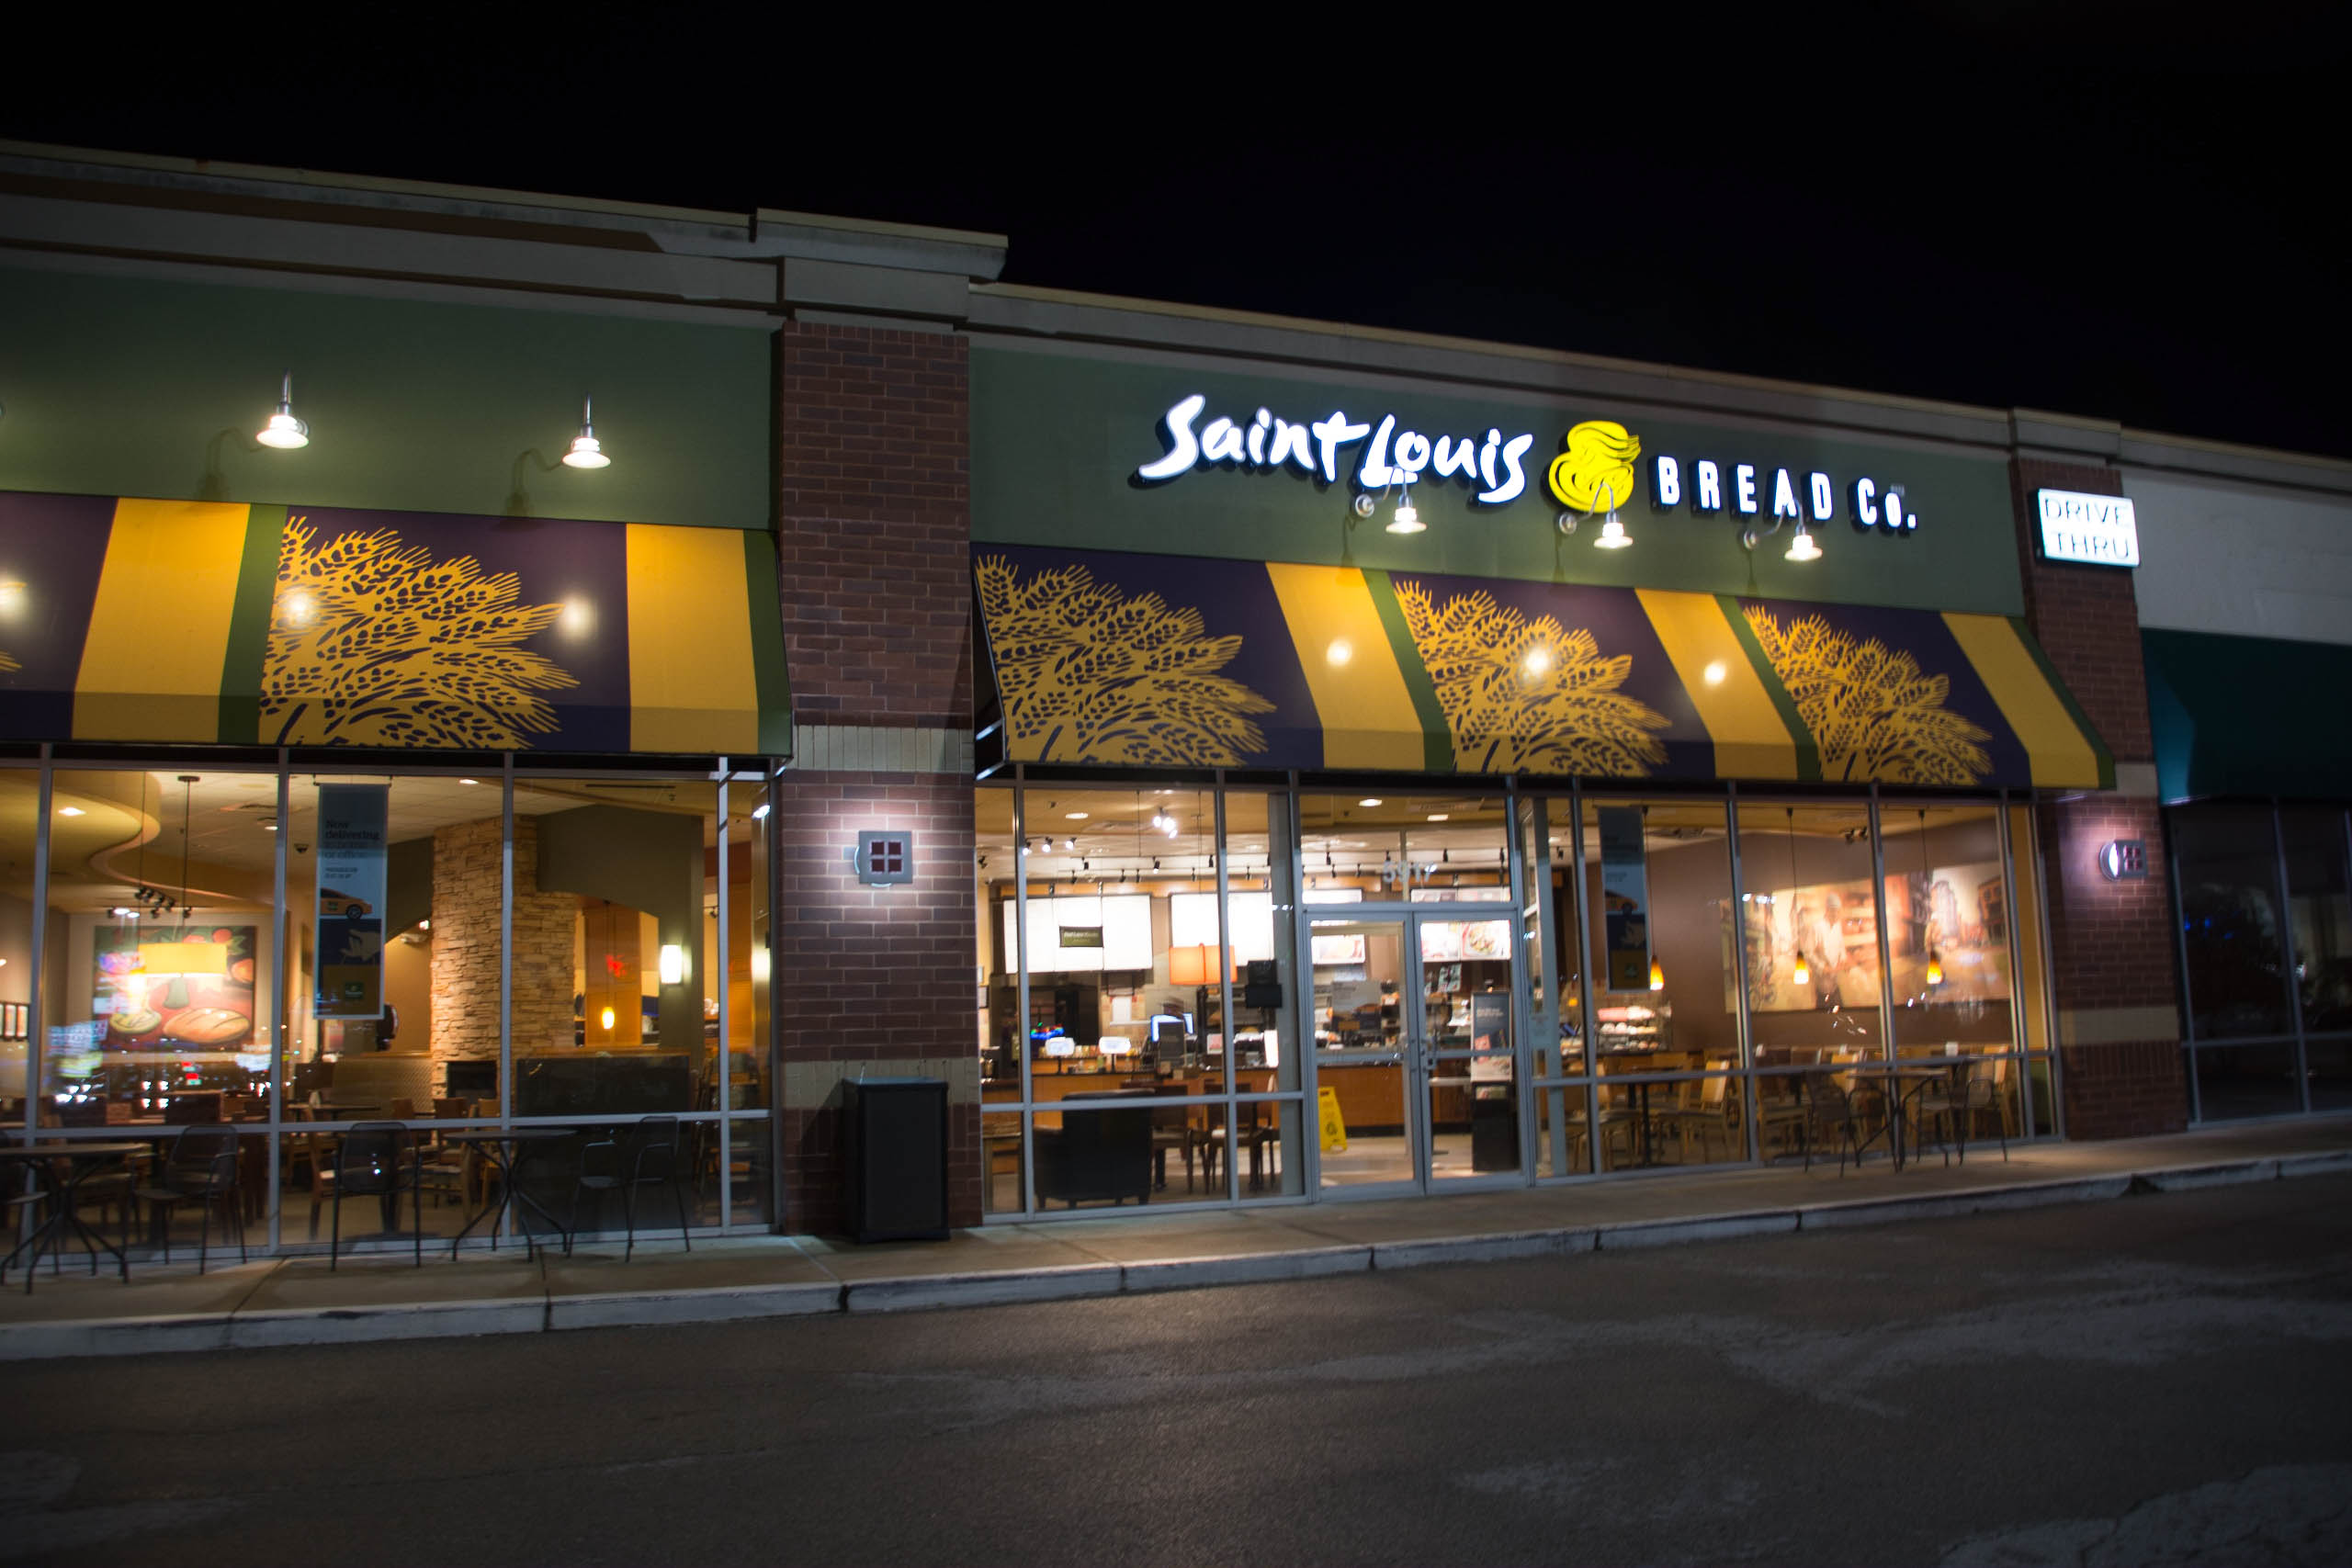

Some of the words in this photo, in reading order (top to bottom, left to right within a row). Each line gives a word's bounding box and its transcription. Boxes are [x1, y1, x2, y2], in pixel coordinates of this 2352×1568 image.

[1138, 393, 1370, 482] Saint
[1360, 413, 1533, 503] Louis
[1657, 456, 1833, 521] BREAD
[2044, 497, 2132, 528] DRIVE
[2051, 529, 2129, 559] THRU
[324, 819, 350, 829] Now
[324, 829, 381, 841] delivering
[1383, 860, 1434, 883] 5917
